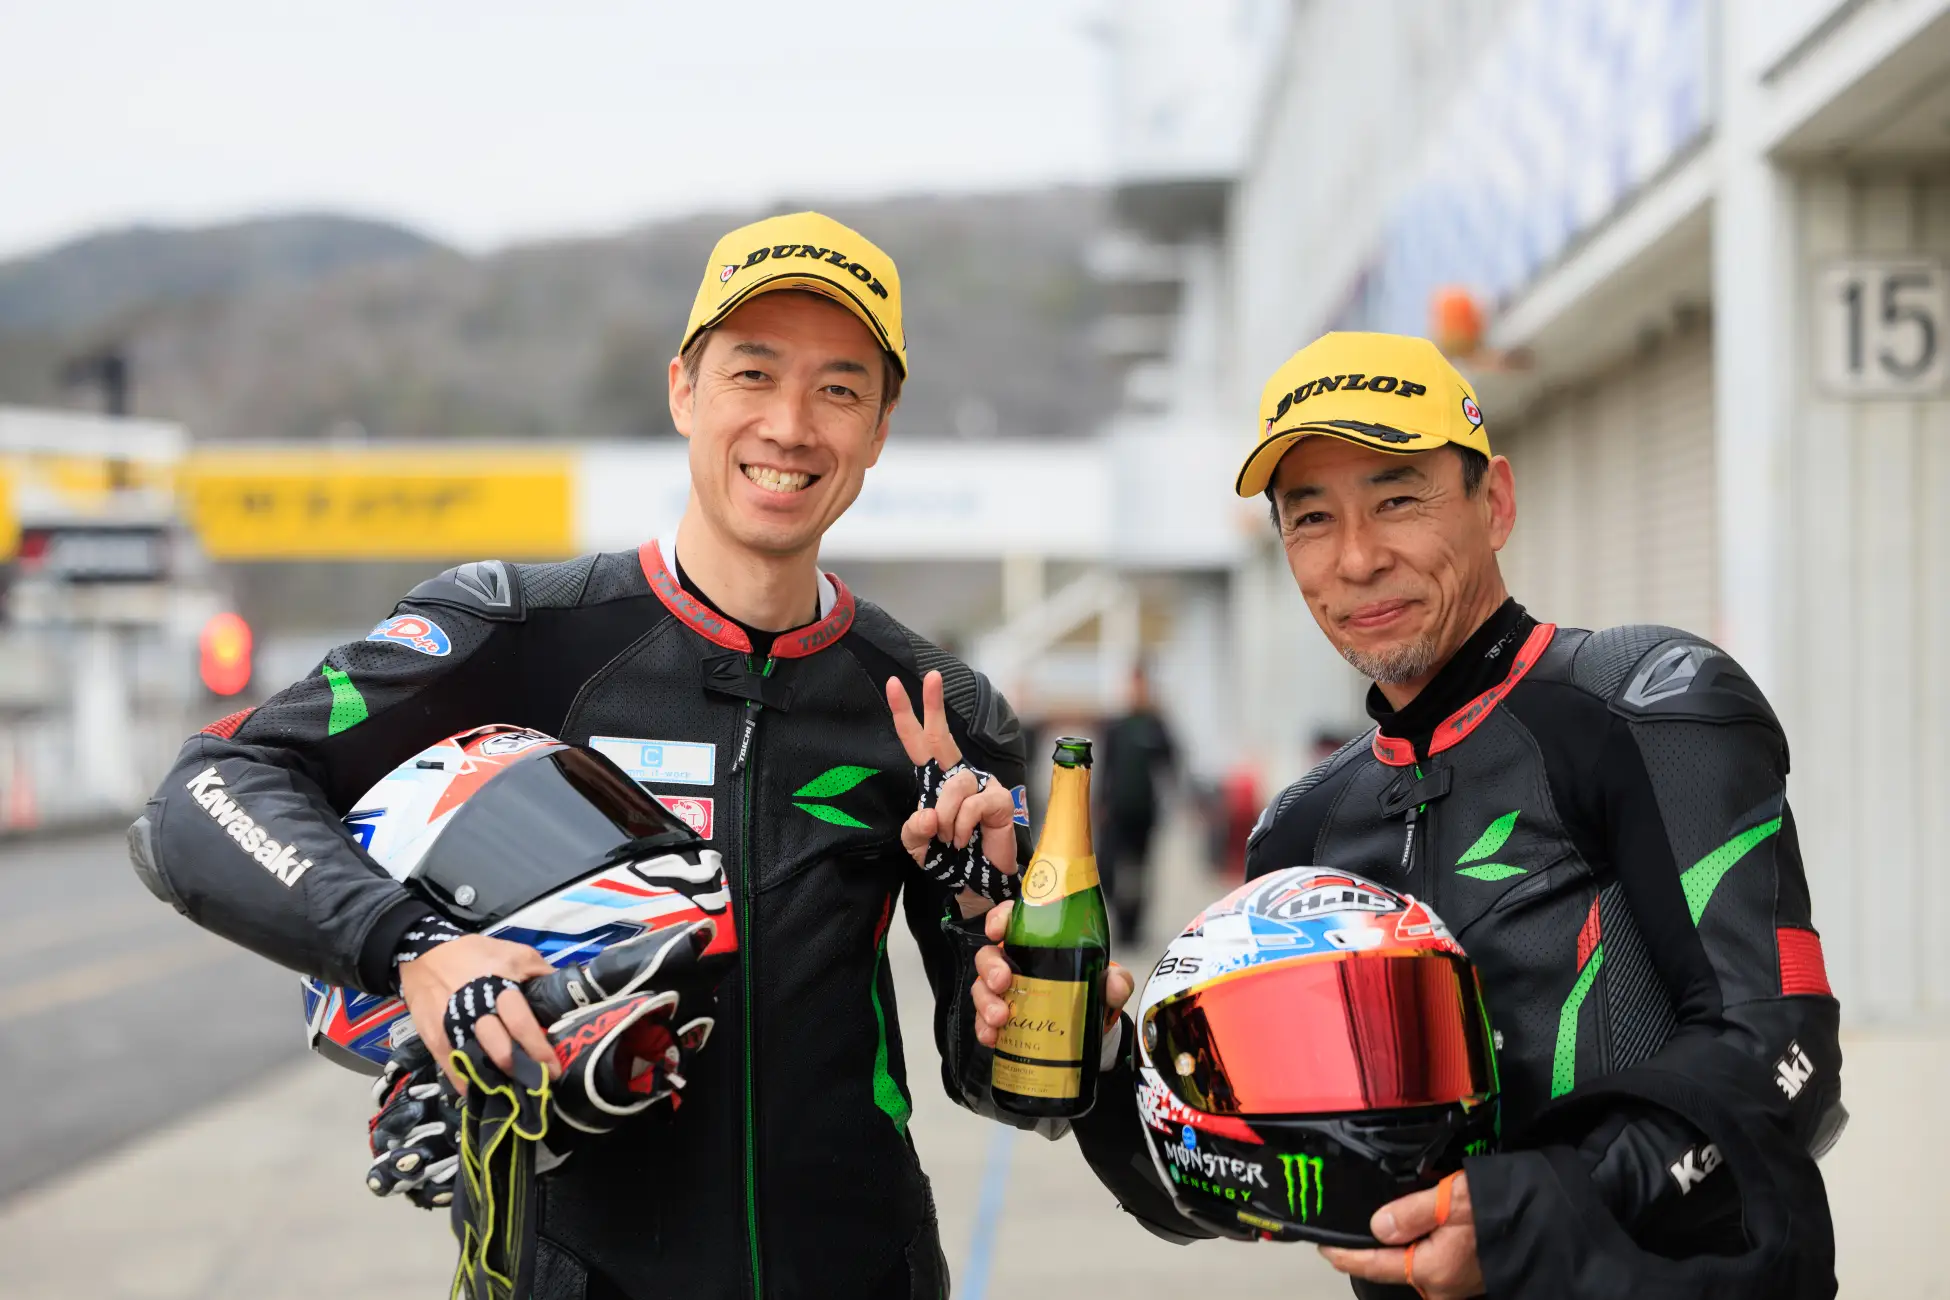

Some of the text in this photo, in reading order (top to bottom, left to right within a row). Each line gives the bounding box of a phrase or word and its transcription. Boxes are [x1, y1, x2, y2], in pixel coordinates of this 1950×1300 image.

[742, 245, 888, 299] DUNLOP
[1840, 274, 1936, 381] 15
[1273, 374, 1427, 422] DUNLOP
[739, 726, 752, 762] TAICHI
[185, 765, 313, 889] Kawasaki
[1000, 1035, 1041, 1052] ARKLING
[1164, 1141, 1269, 1188] MONSTER
[1181, 1174, 1252, 1201] ENERGY
